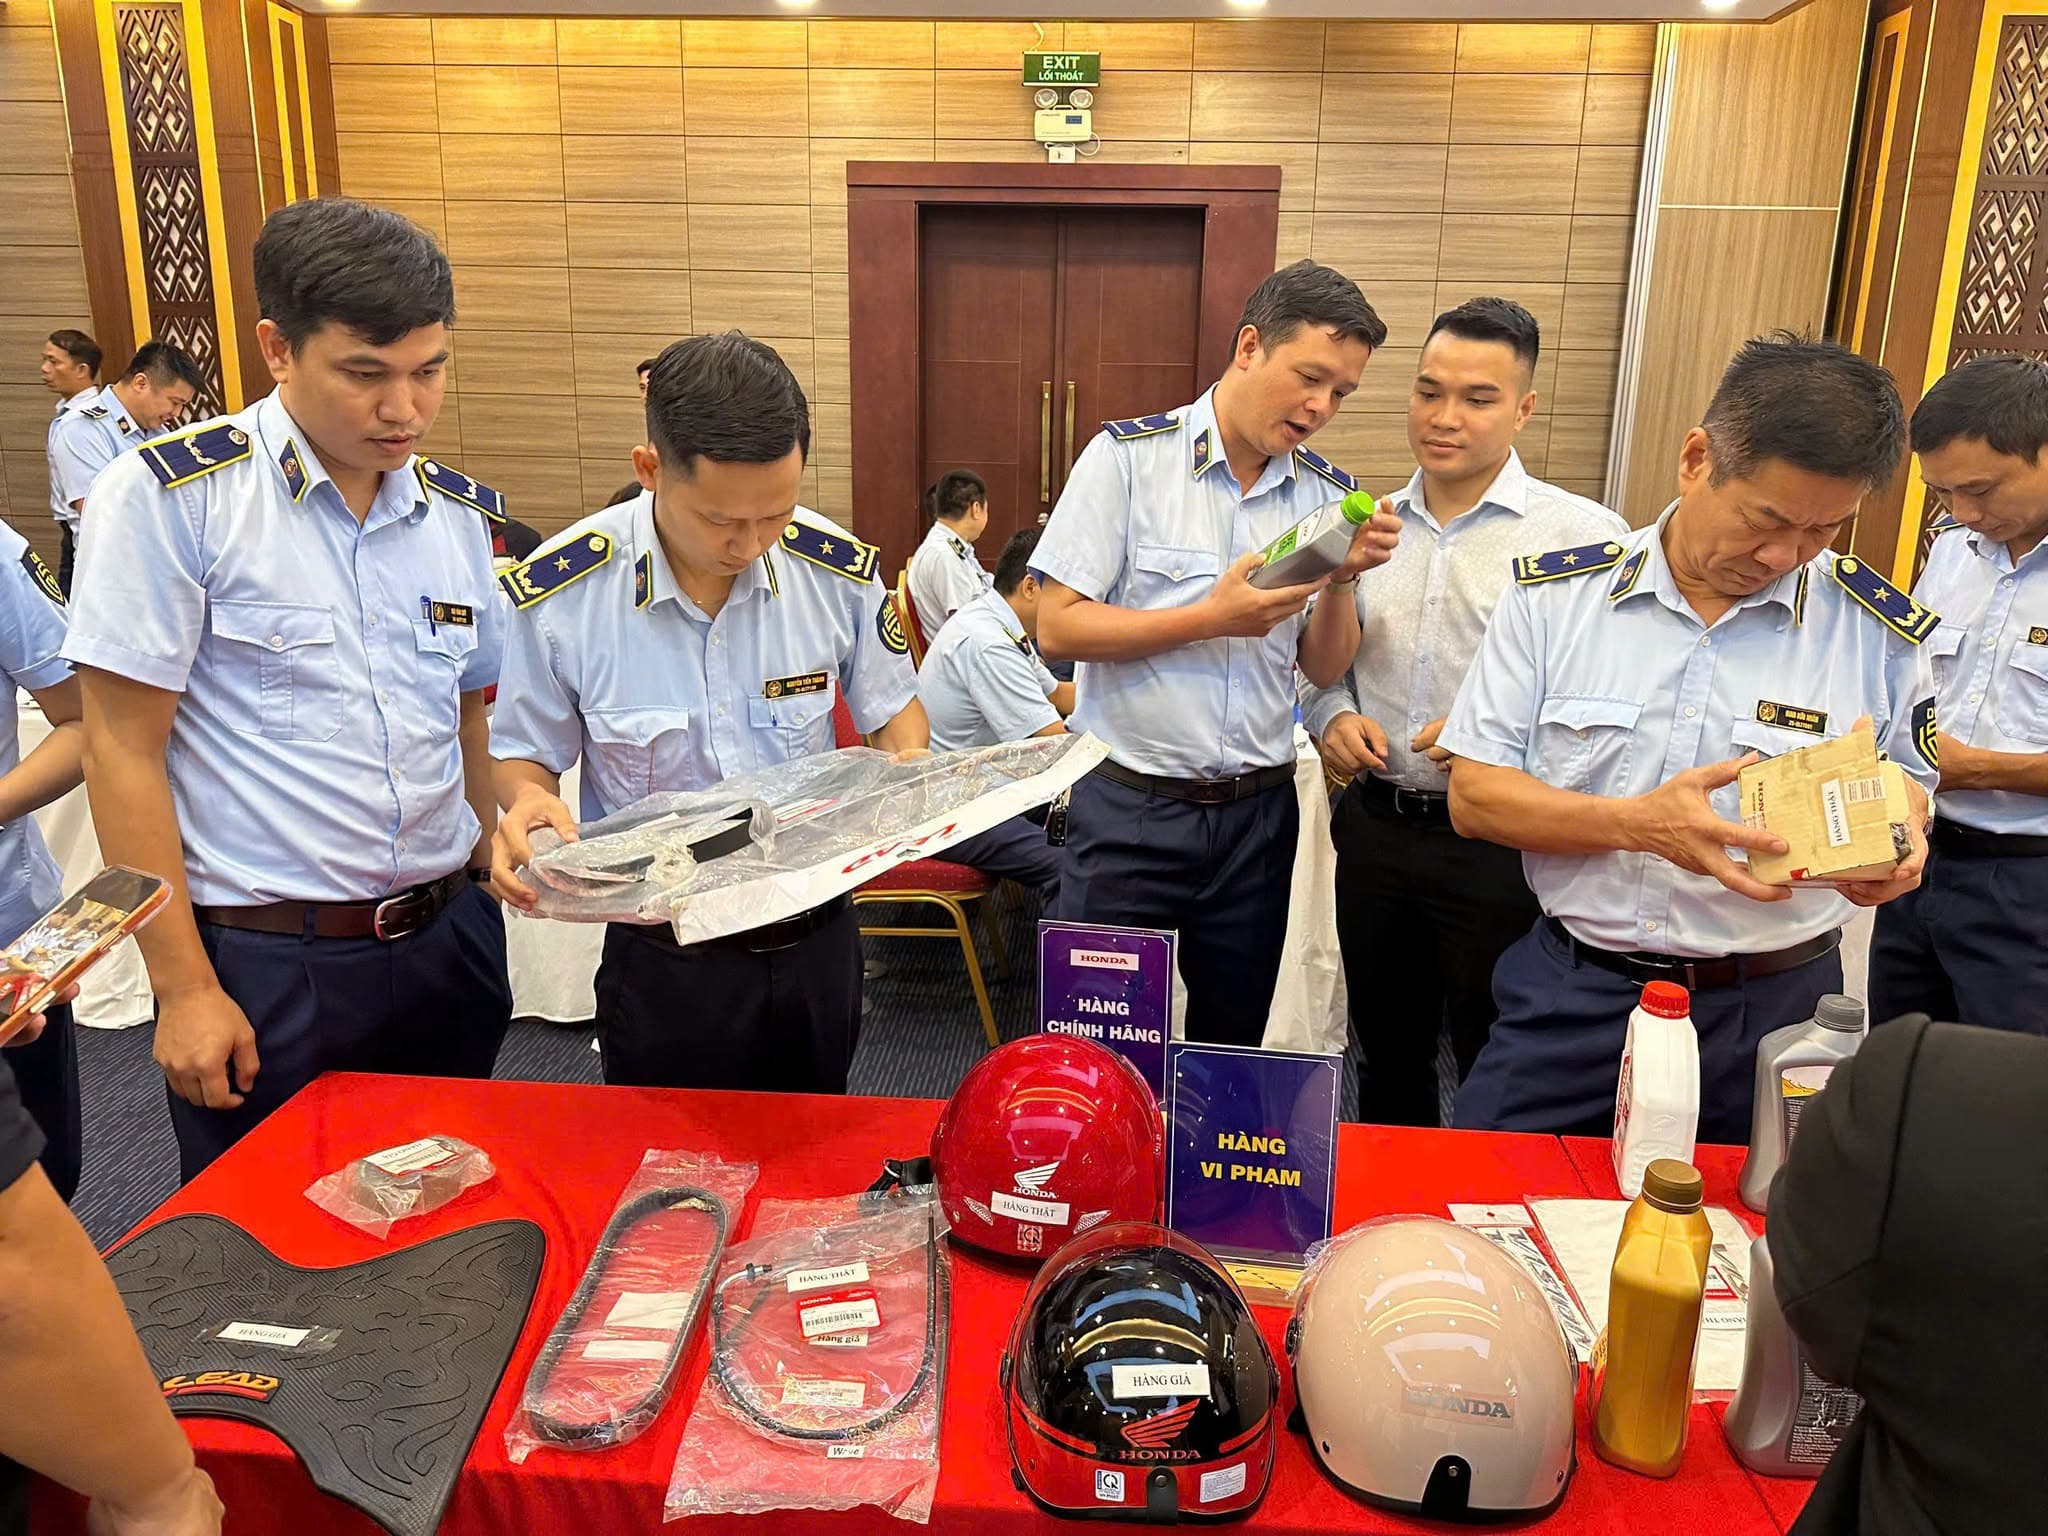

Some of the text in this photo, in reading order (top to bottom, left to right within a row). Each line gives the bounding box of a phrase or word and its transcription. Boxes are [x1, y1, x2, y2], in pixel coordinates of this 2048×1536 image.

[1043, 56, 1080, 69] EXIT
[1039, 69, 1084, 80] LỐI THOÁT
[1080, 954, 1128, 965] HONDA
[1078, 996, 1130, 1016] HÀNG
[1047, 1019, 1161, 1044] CHÍNH HÃNG
[1218, 1130, 1287, 1156] HÀNG
[1200, 1161, 1301, 1188] VI PHẠM
[1012, 1186, 1057, 1198] HONDA
[1003, 1201, 1029, 1215] HÀNG
[163, 1371, 279, 1391] LEAD
[1133, 1372, 1192, 1387] HÀNG GIẢ
[1119, 1449, 1202, 1461] HONDA
